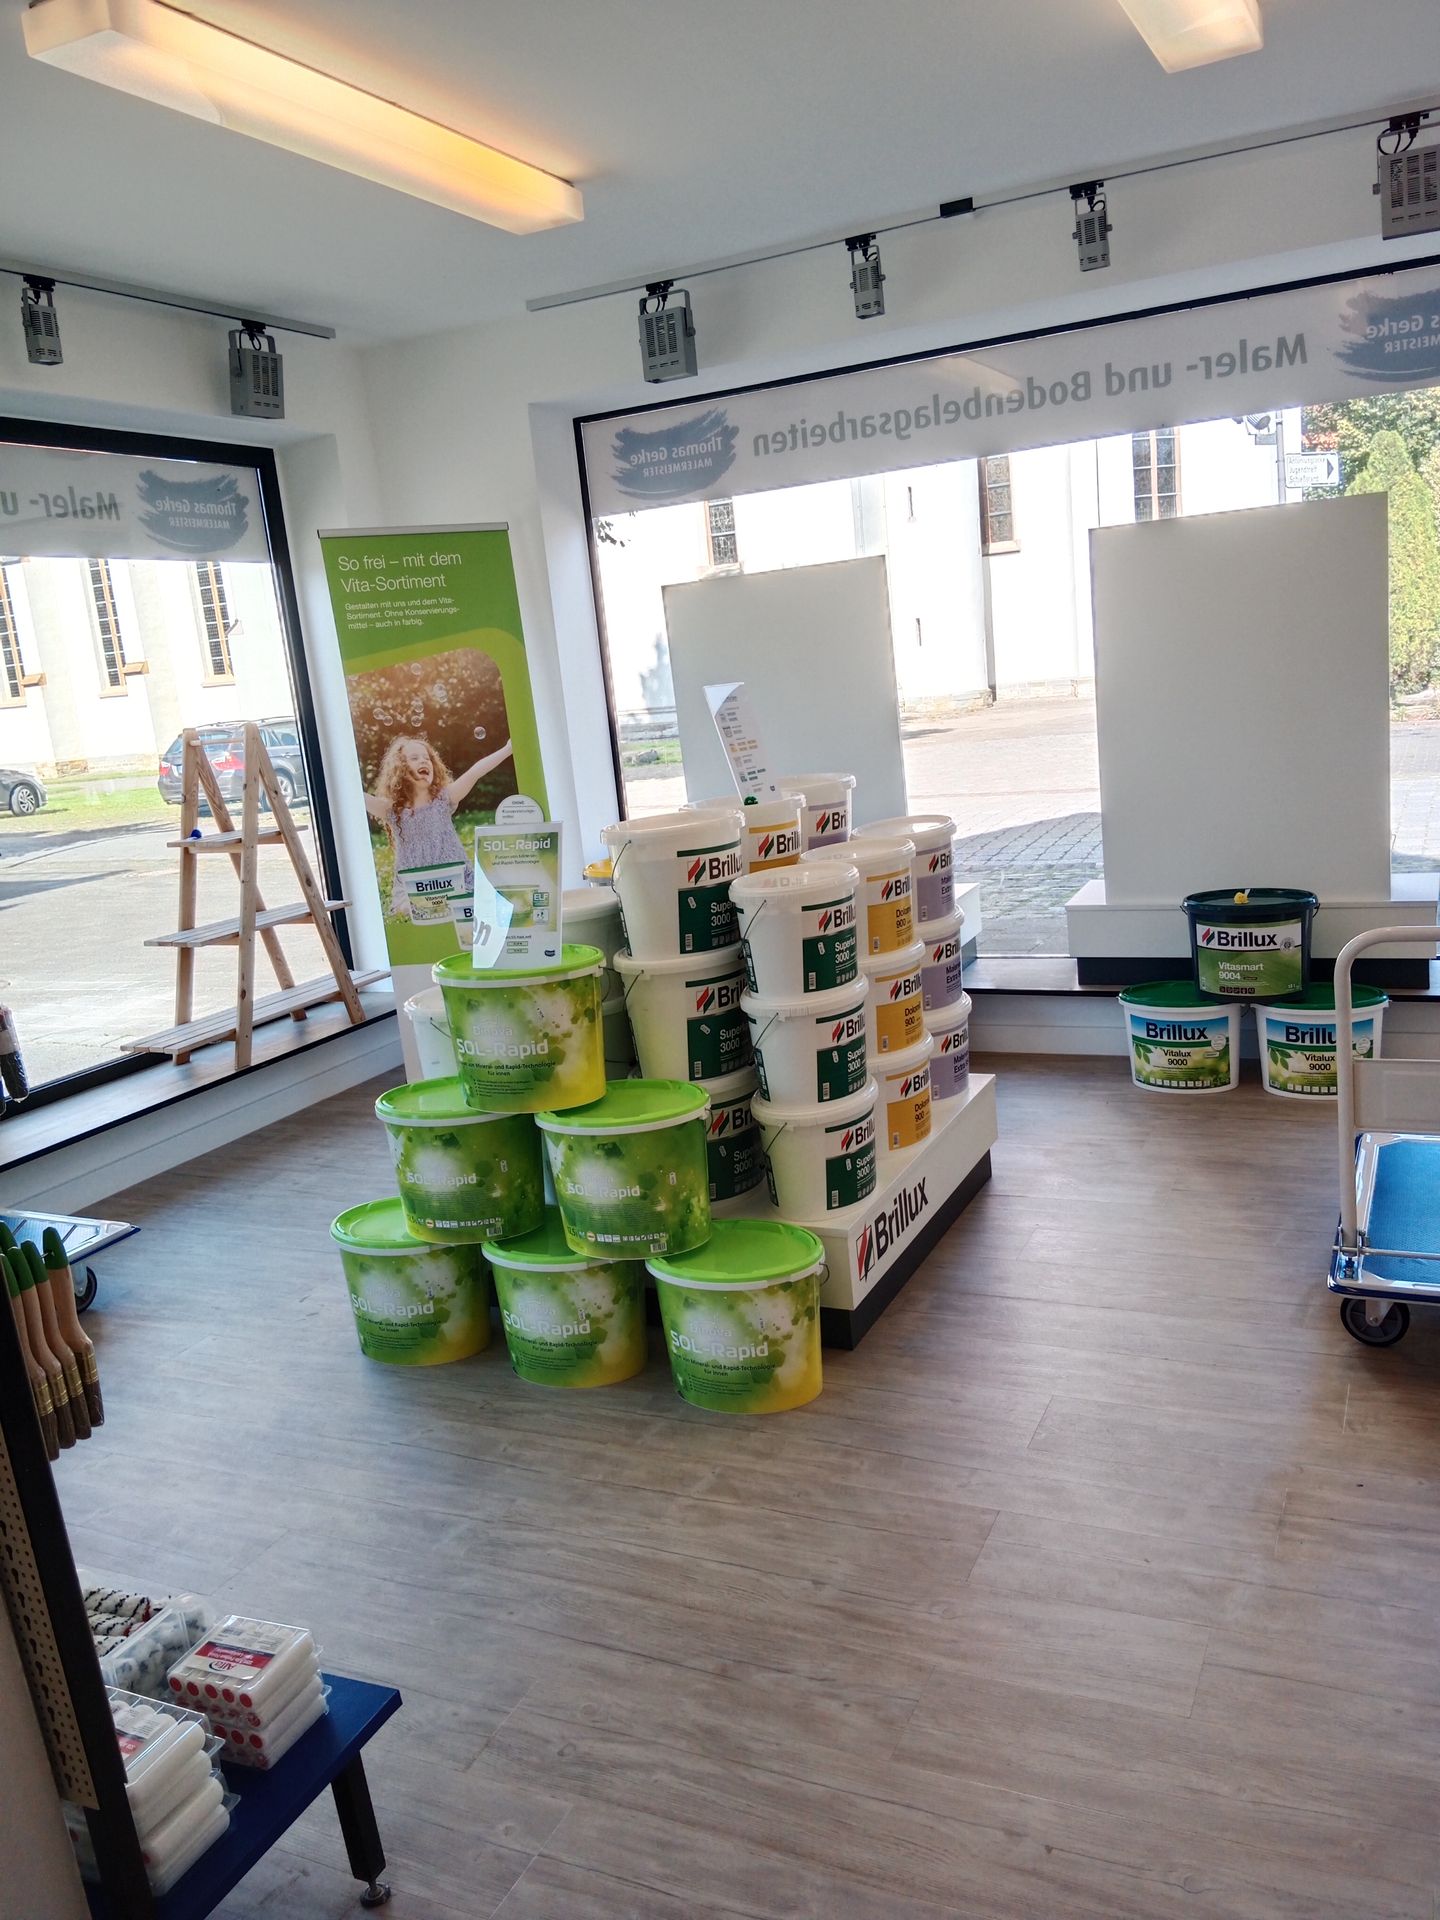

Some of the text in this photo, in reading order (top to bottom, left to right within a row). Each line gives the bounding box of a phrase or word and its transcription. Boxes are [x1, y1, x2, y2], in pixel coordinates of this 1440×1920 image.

[338, 556, 360, 571] So
[364, 554, 386, 570] frei
[402, 553, 425, 568] mit
[429, 552, 462, 566] dem
[341, 573, 447, 593] Vita-Sortiment
[345, 602, 379, 611] Gestalten
[380, 601, 392, 610] mit
[393, 601, 406, 609] uns
[407, 599, 421, 607] und
[422, 597, 438, 606] dem
[384, 609, 403, 618] Ohne
[405, 606, 460, 617] Konservierungs-
[348, 621, 368, 630] mittel
[375, 619, 393, 629] auch
[394, 619, 401, 627] in
[483, 838, 551, 851] SOL-Rapid
[416, 879, 453, 892] Brillux
[711, 912, 731, 927] 3000
[896, 917, 908, 929] 900
[1217, 931, 1278, 947] Brillux
[835, 950, 850, 964] 3000
[1218, 961, 1265, 971] Vitasmart
[1218, 970, 1241, 980] 9004
[904, 1015, 916, 1028] 900
[1145, 1021, 1208, 1041] Brillux
[1285, 1025, 1336, 1045] Brillu
[456, 1038, 549, 1060] SOL-Rapid
[720, 1038, 741, 1054] 3000
[1162, 1048, 1192, 1058] Vitalux
[1304, 1053, 1336, 1062] Vitalux
[847, 1058, 861, 1073] 3000
[1309, 1063, 1331, 1071] 9000
[857, 1163, 871, 1180] 3000
[874, 1176, 928, 1260] Brillux
[351, 1293, 435, 1319] SOL-Rapid
[503, 1309, 591, 1338] SOL-Rapid
[670, 1330, 769, 1361] SOL-Rapid
